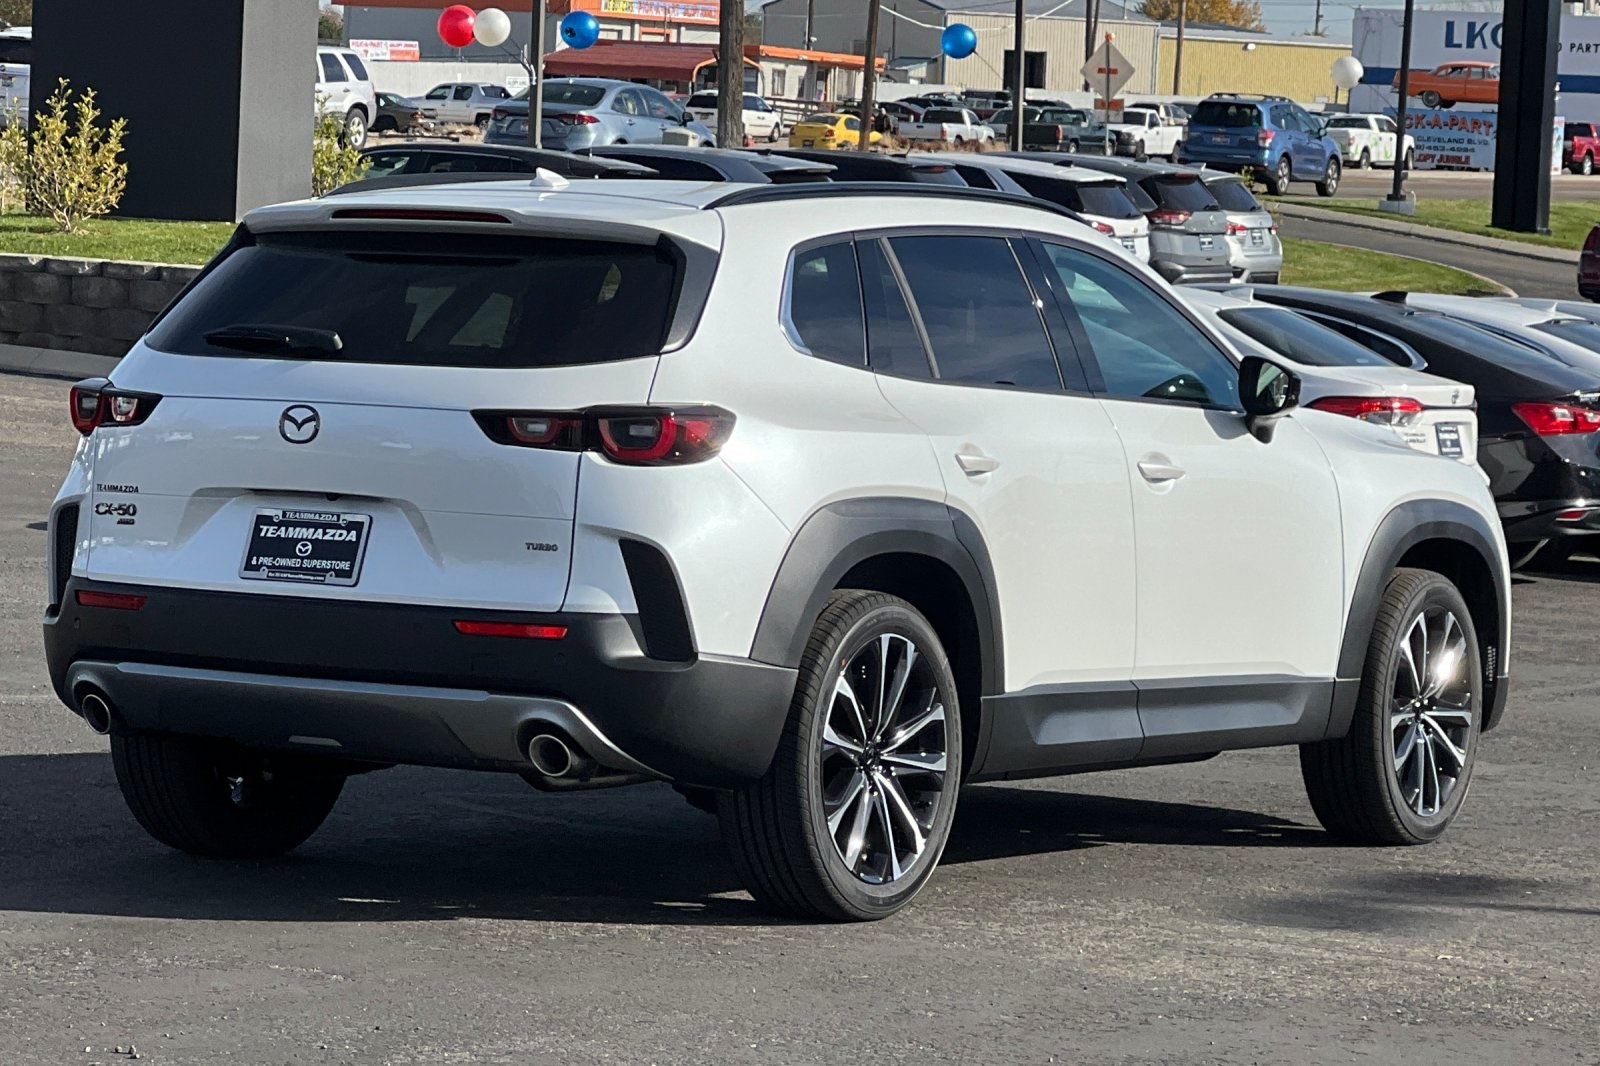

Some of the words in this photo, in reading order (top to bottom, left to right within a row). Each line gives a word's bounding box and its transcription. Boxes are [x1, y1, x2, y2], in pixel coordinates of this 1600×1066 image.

[1404, 113, 1493, 136] CK-A-PART
[1416, 135, 1465, 144] CLEVELAND
[96, 484, 139, 493] TEAMMAZDA
[95, 502, 137, 516] CX-50
[285, 511, 338, 522] TEAMMAZDA
[259, 525, 357, 541] TEAMMAZDA
[525, 542, 558, 552] TURBO
[251, 556, 257, 565] &
[258, 556, 302, 568] PRE-OWNED
[302, 559, 351, 570] SUPERSTORE
